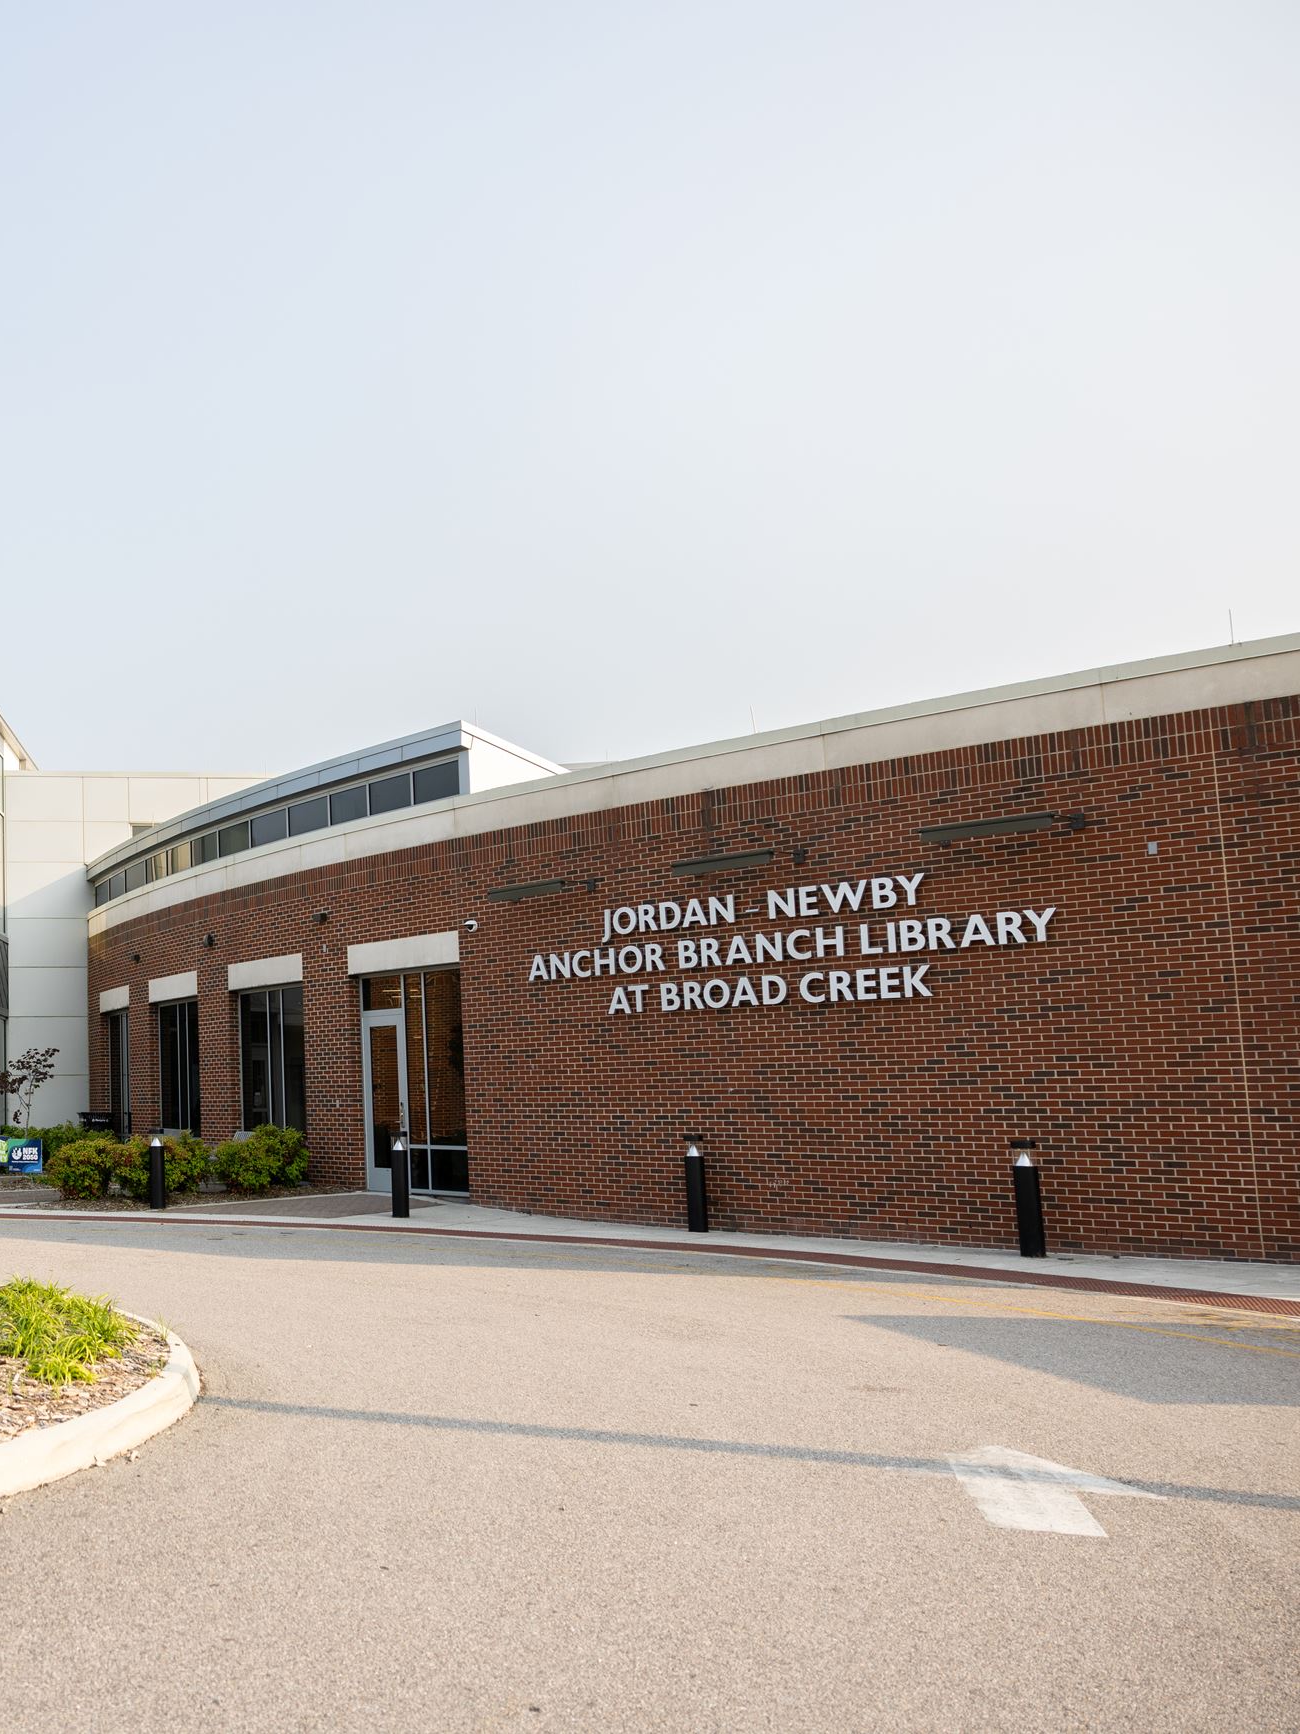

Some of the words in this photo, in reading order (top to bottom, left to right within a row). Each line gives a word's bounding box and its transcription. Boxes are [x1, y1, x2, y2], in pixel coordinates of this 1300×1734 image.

[602, 894, 736, 943] JORDAN
[768, 872, 925, 920] NEWBY
[528, 941, 666, 982] ANCHOR
[677, 925, 845, 969] BRANCH
[859, 907, 1057, 955] LIBRARY
[608, 984, 649, 1015] AT
[660, 975, 788, 1013] BROAD
[799, 964, 933, 1004] CREEK
[22, 1147, 38, 1155] NFK
